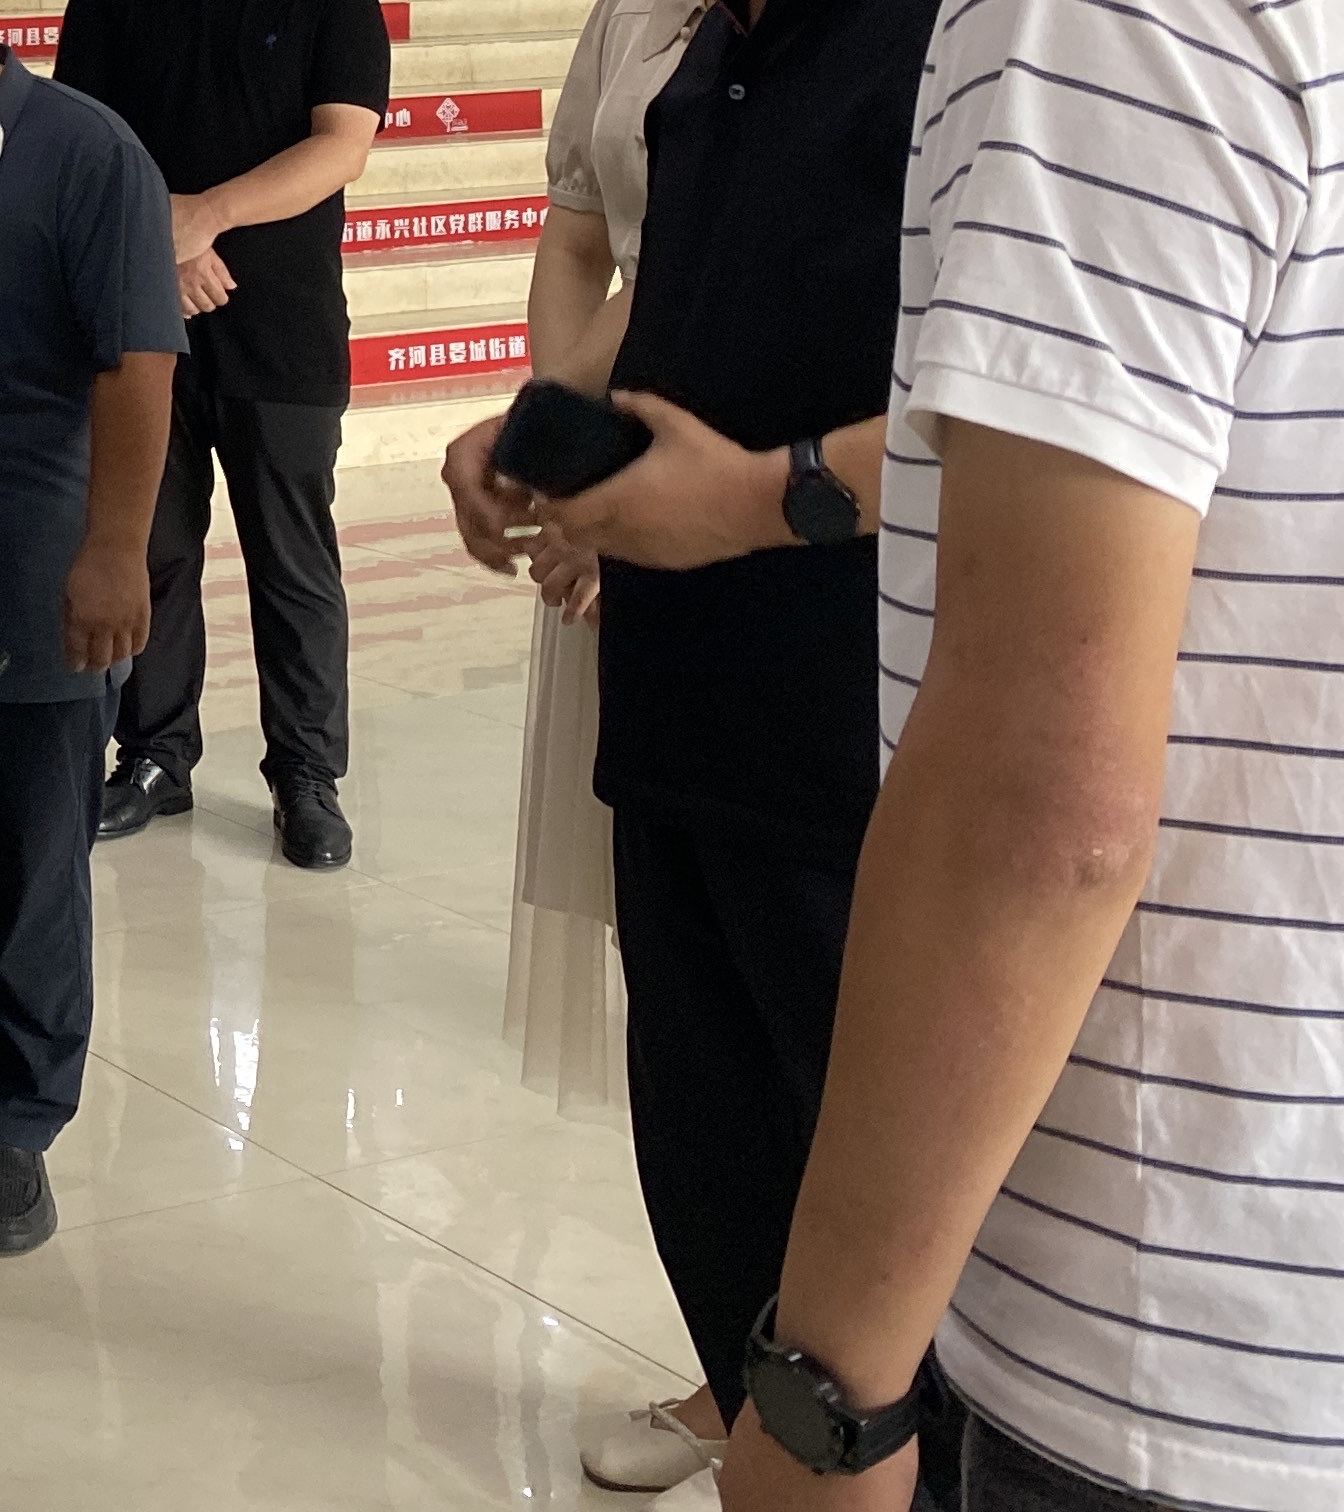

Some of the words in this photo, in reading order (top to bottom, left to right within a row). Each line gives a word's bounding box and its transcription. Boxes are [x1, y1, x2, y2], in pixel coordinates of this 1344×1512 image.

[388, 336, 526, 371] 齐河县晏城街道
